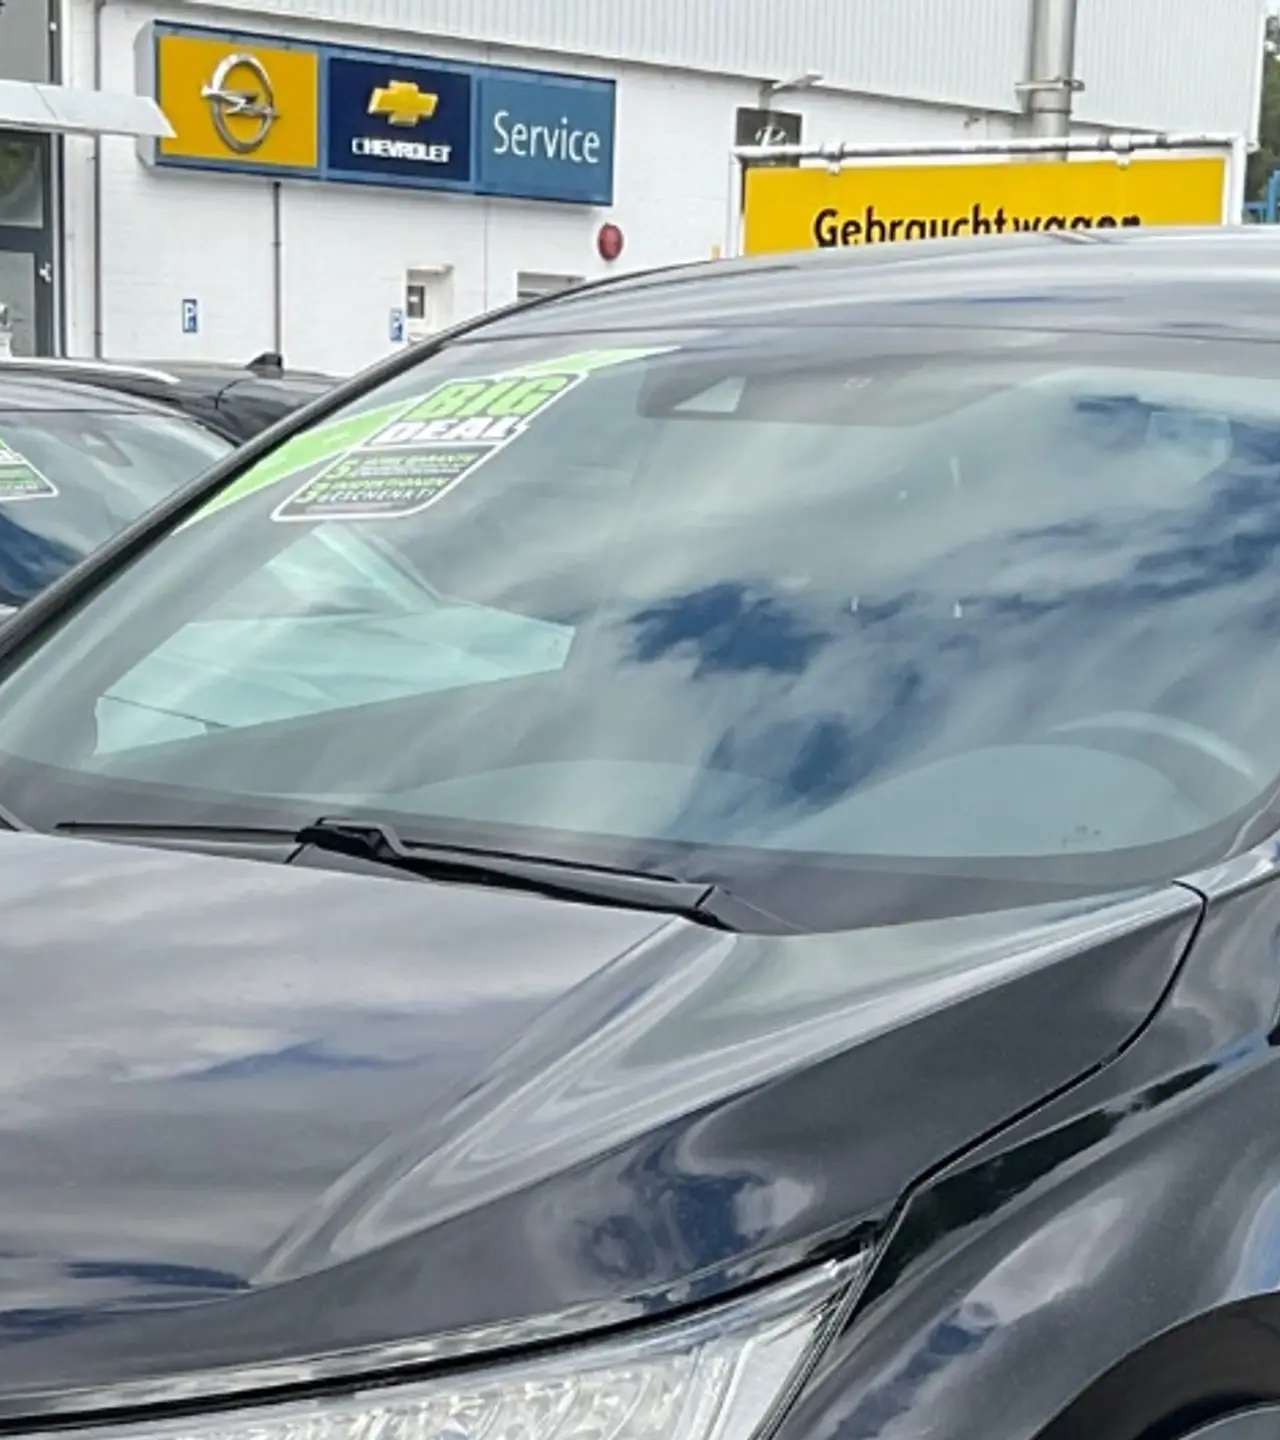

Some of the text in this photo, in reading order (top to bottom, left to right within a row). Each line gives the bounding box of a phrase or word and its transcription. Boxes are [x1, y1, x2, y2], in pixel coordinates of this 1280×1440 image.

[351, 137, 451, 163] CHEVROLET
[493, 110, 600, 163] Service
[404, 376, 568, 421] BIG
[371, 416, 519, 444] DEAL
